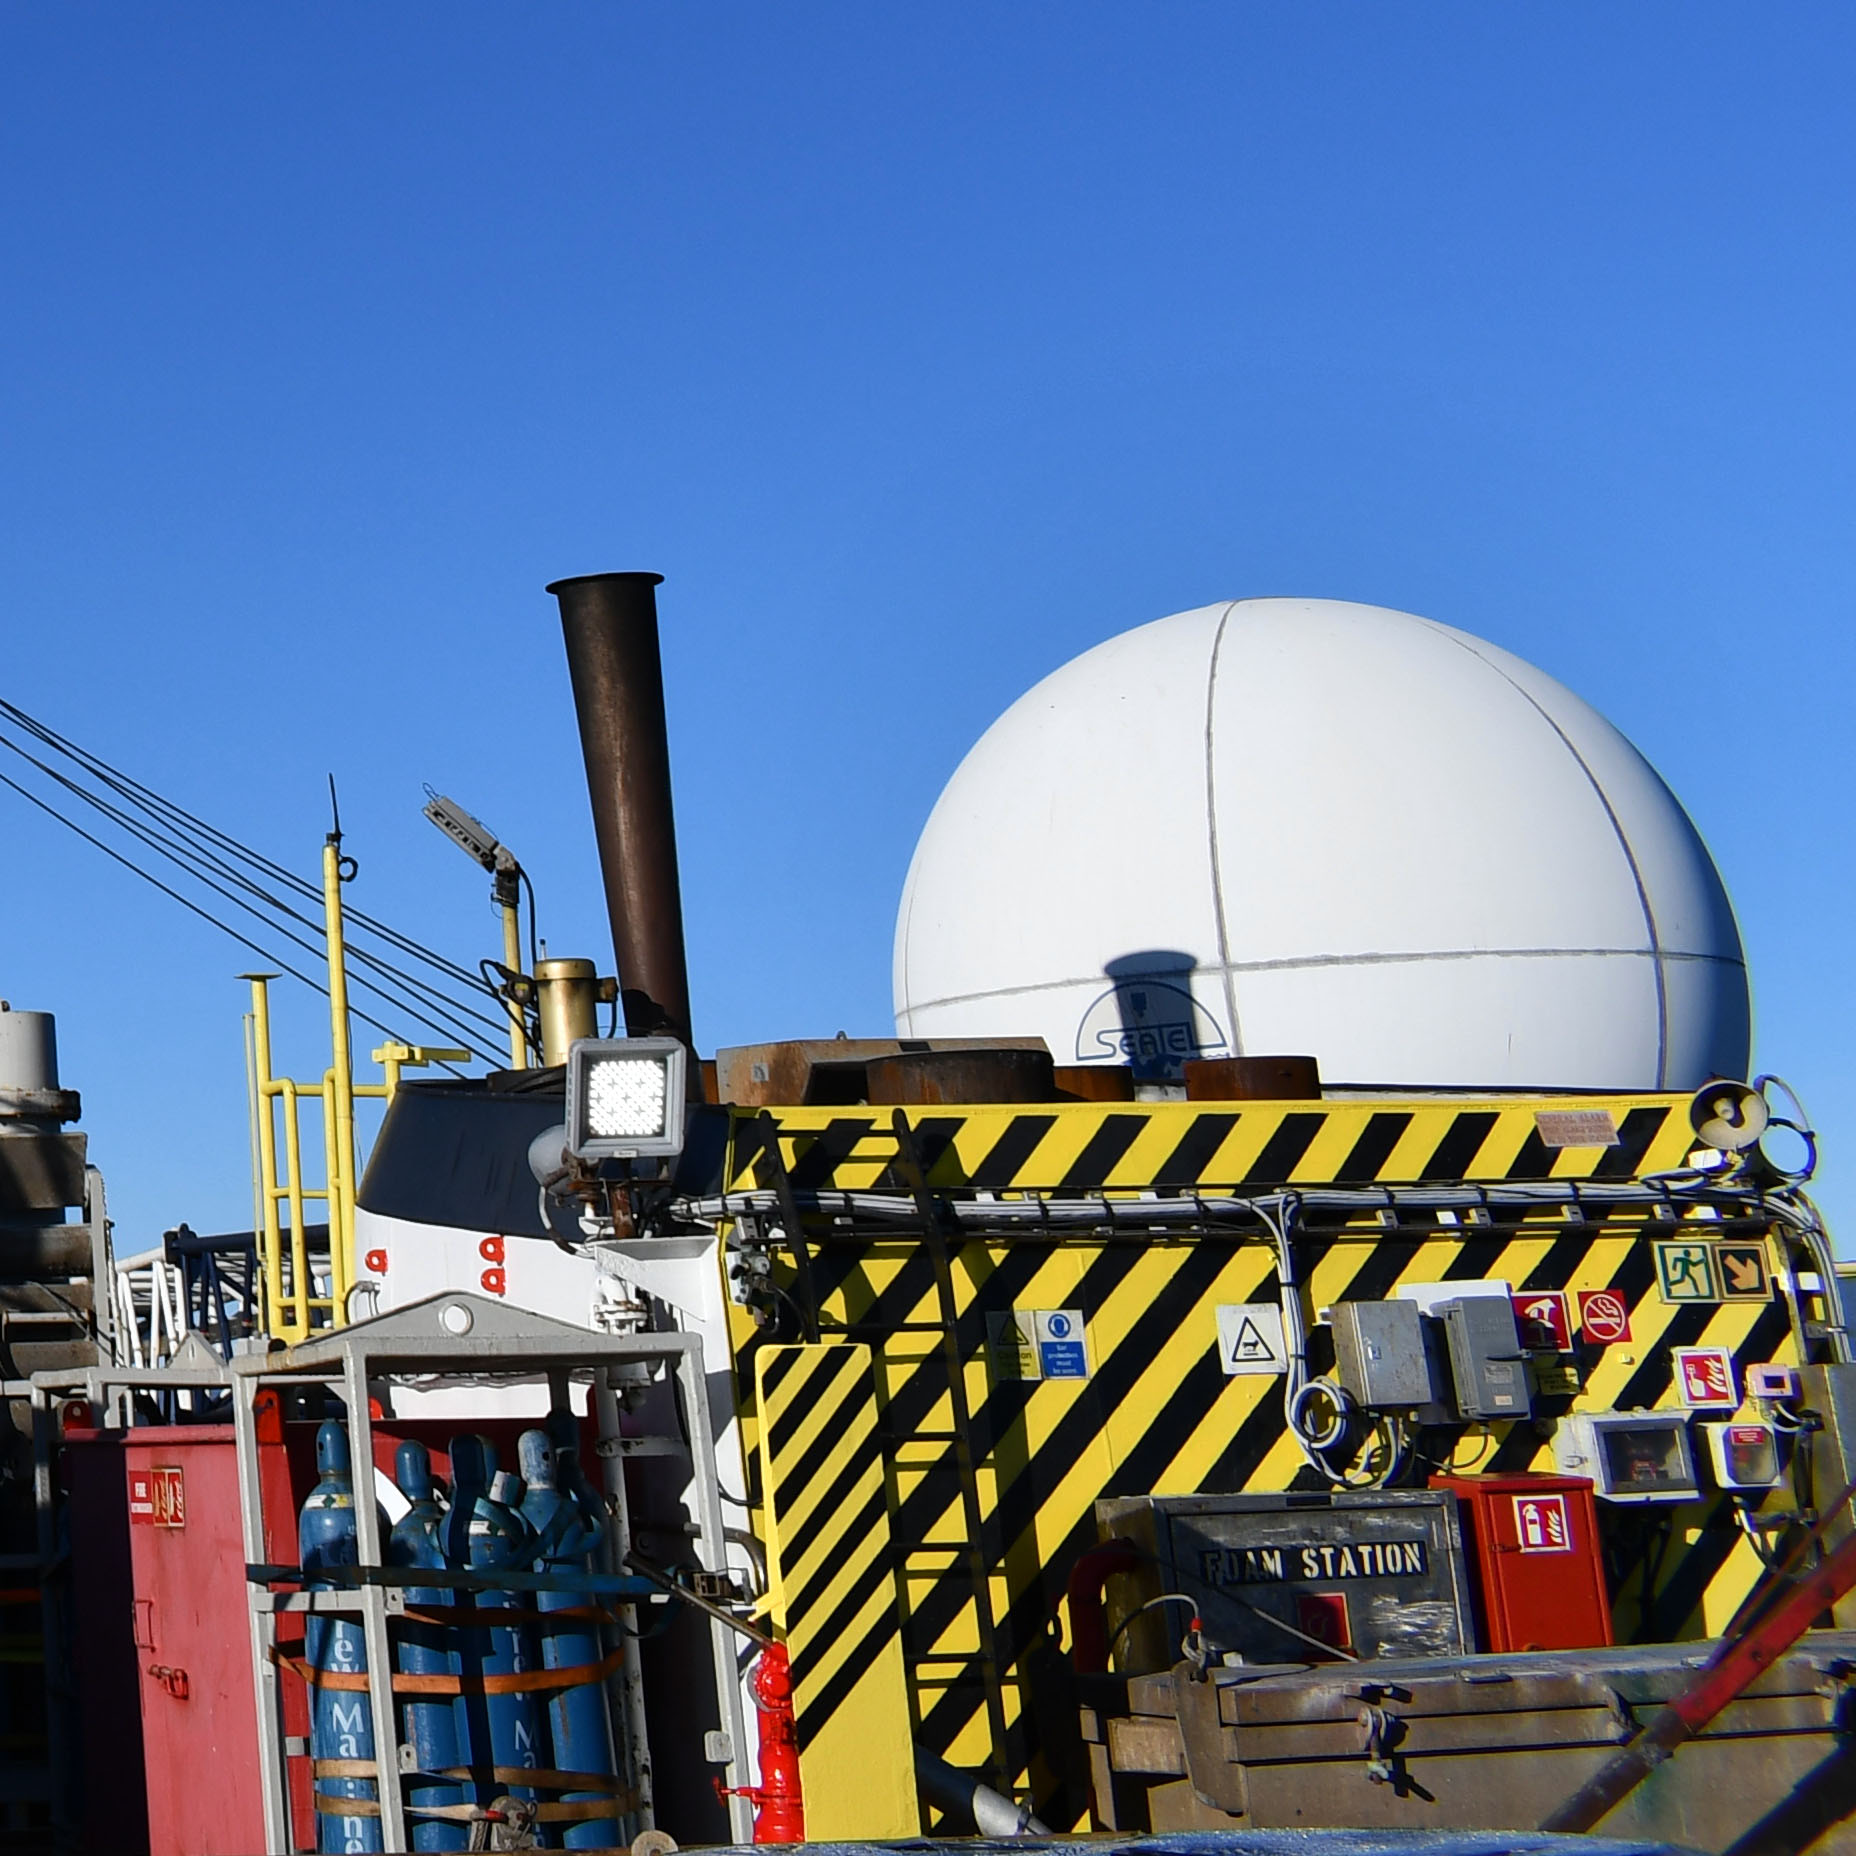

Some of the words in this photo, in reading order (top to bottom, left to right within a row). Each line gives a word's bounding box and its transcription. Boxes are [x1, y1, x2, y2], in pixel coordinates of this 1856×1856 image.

[1204, 1548, 1284, 1585] FOAM
[1301, 1542, 1422, 1578] STATION
[332, 1701, 366, 1855] Mane
